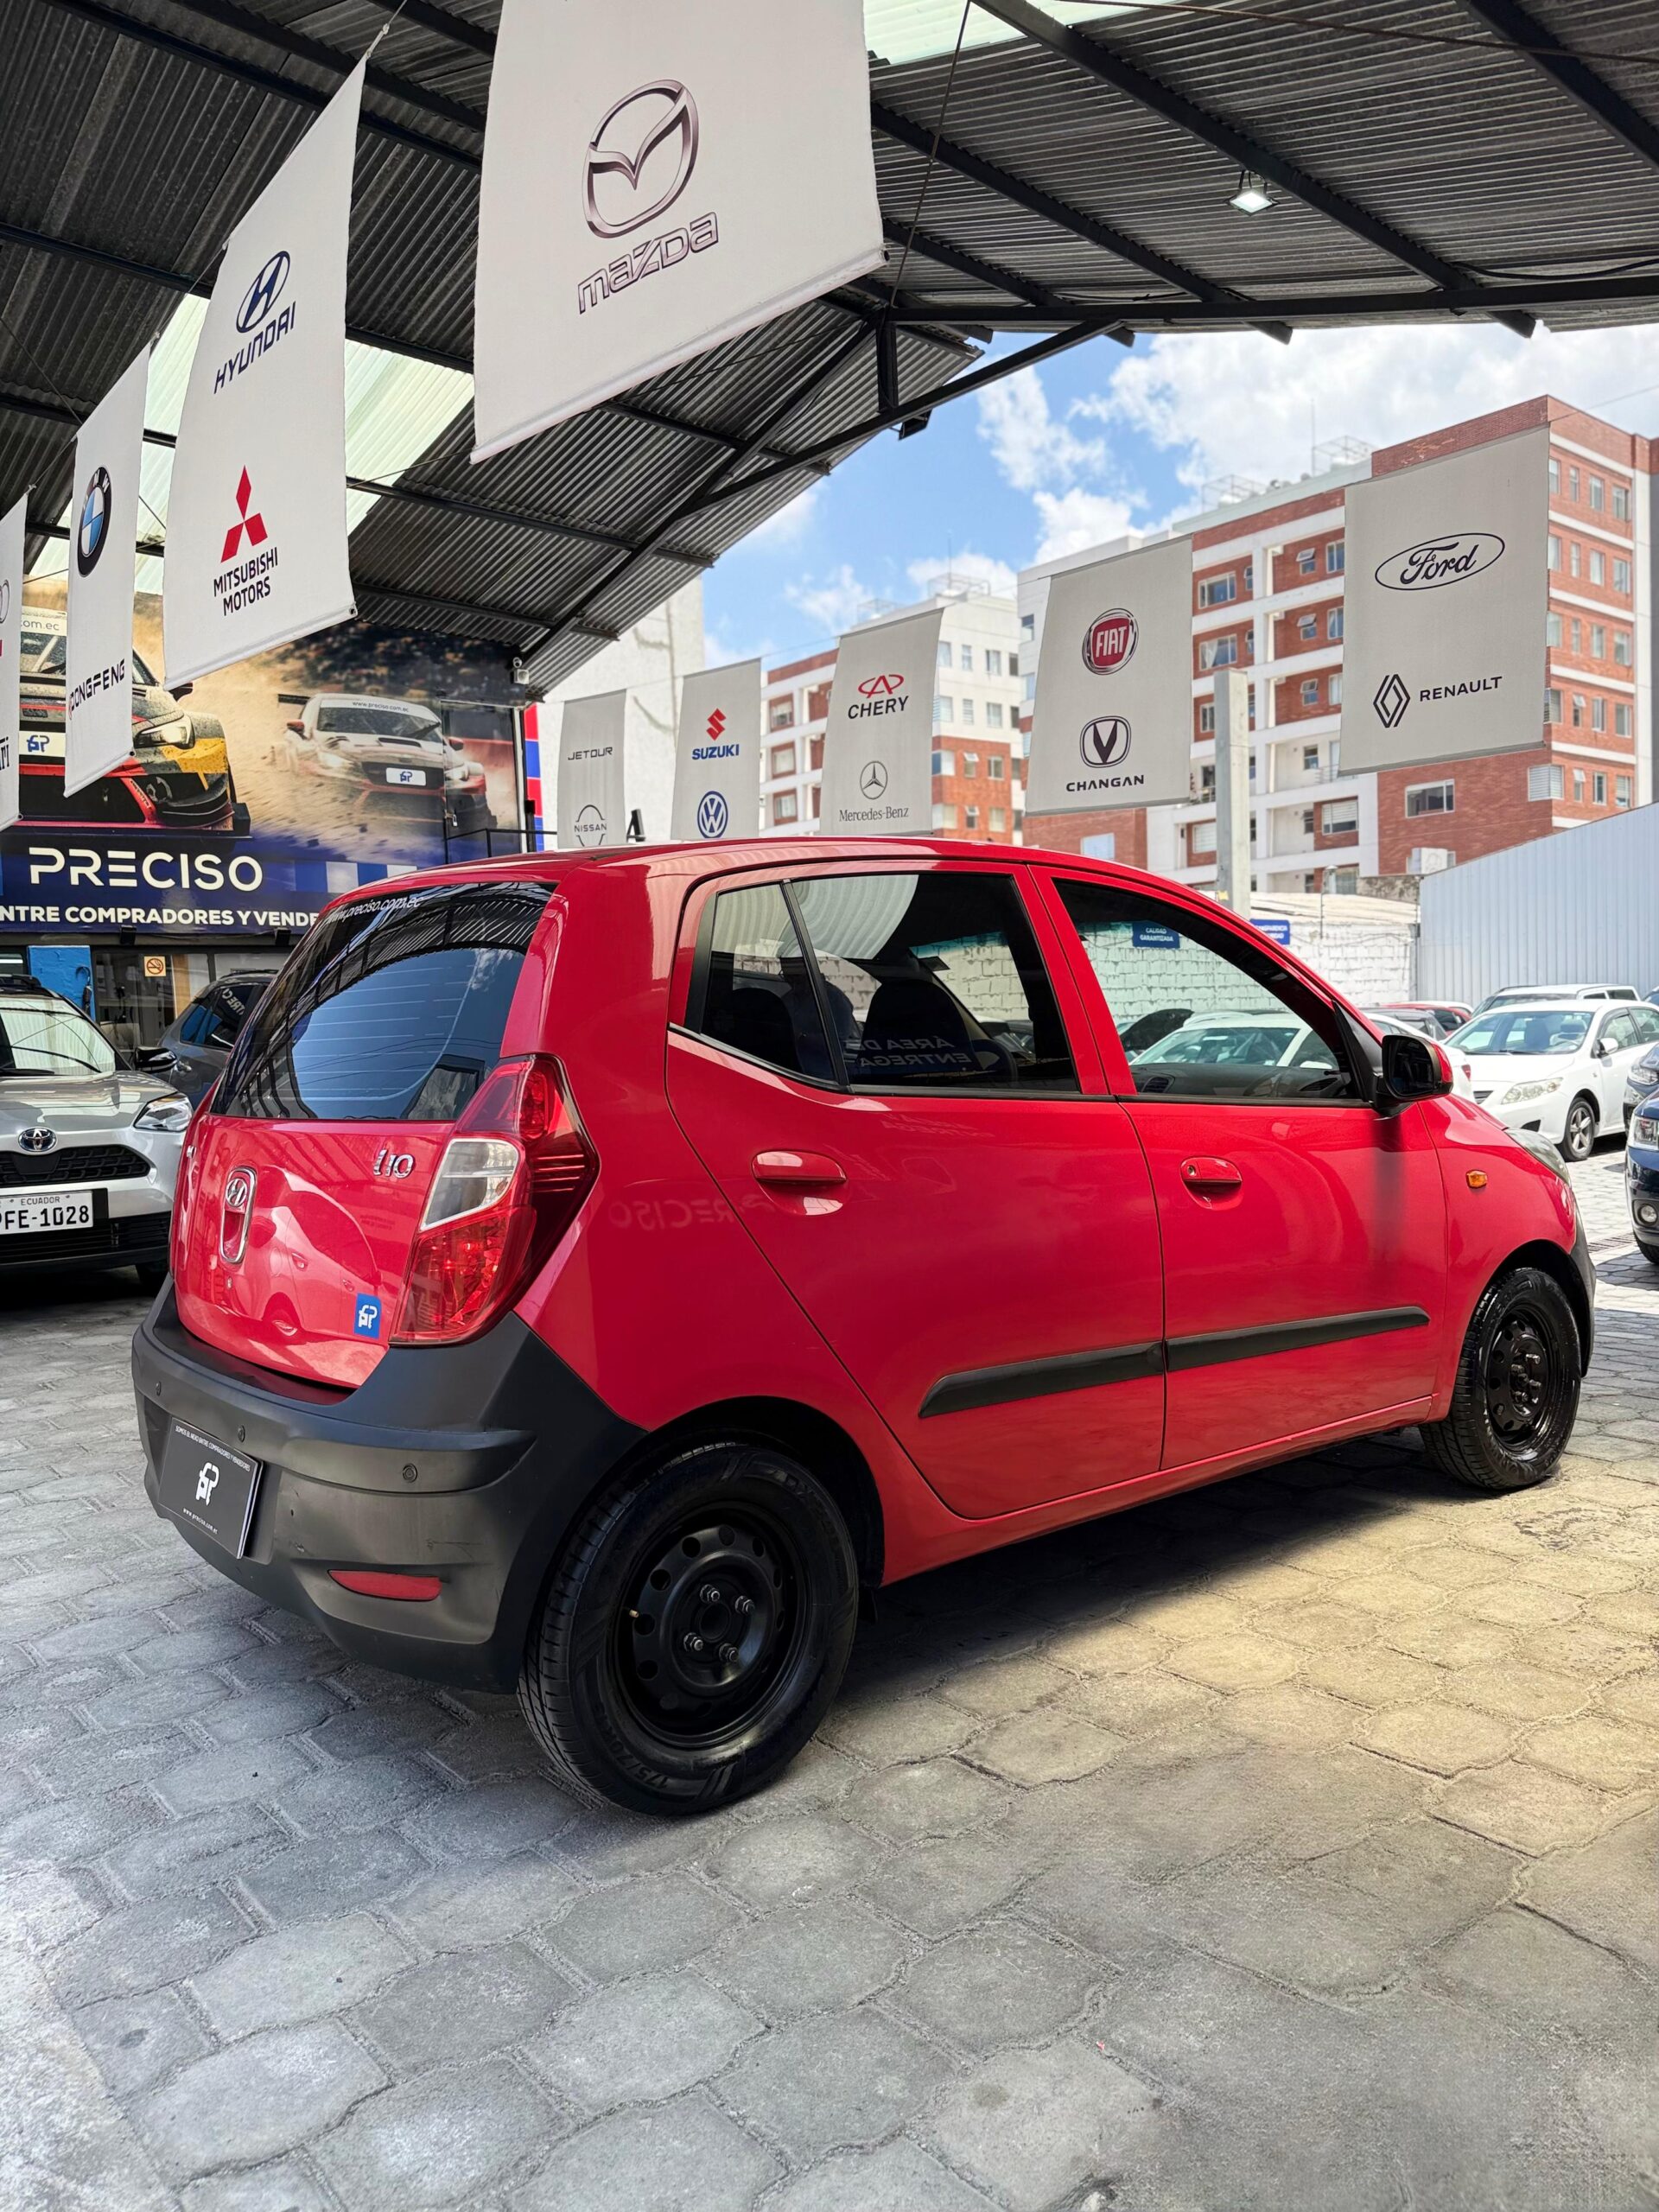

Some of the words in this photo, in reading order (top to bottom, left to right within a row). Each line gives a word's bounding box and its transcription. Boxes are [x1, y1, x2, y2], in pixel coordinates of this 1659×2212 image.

[213, 300, 296, 395] HYUNDAI
[213, 546, 278, 598] MITSUBISHI
[1400, 541, 1479, 585] Ford
[223, 575, 271, 616] MOTORS
[1095, 626, 1128, 658] FIAT
[69, 658, 125, 712] DONGFENG
[1419, 676, 1503, 702] RENAULT
[848, 695, 910, 720] CHERY
[567, 746, 613, 761] JETOUR
[691, 743, 740, 760] SUZUKI
[1065, 774, 1145, 792] CHANGAN
[838, 805, 910, 823] Mercedes-Benz
[574, 823, 607, 832] NISSAN
[29, 847, 264, 892] PRECISO
[65, 906, 234, 925] COMPRADORES
[236, 910, 252, 925] Y
[20, 1196, 60, 1206] ECUADOR
[0, 1205, 90, 1230] FE-1028
